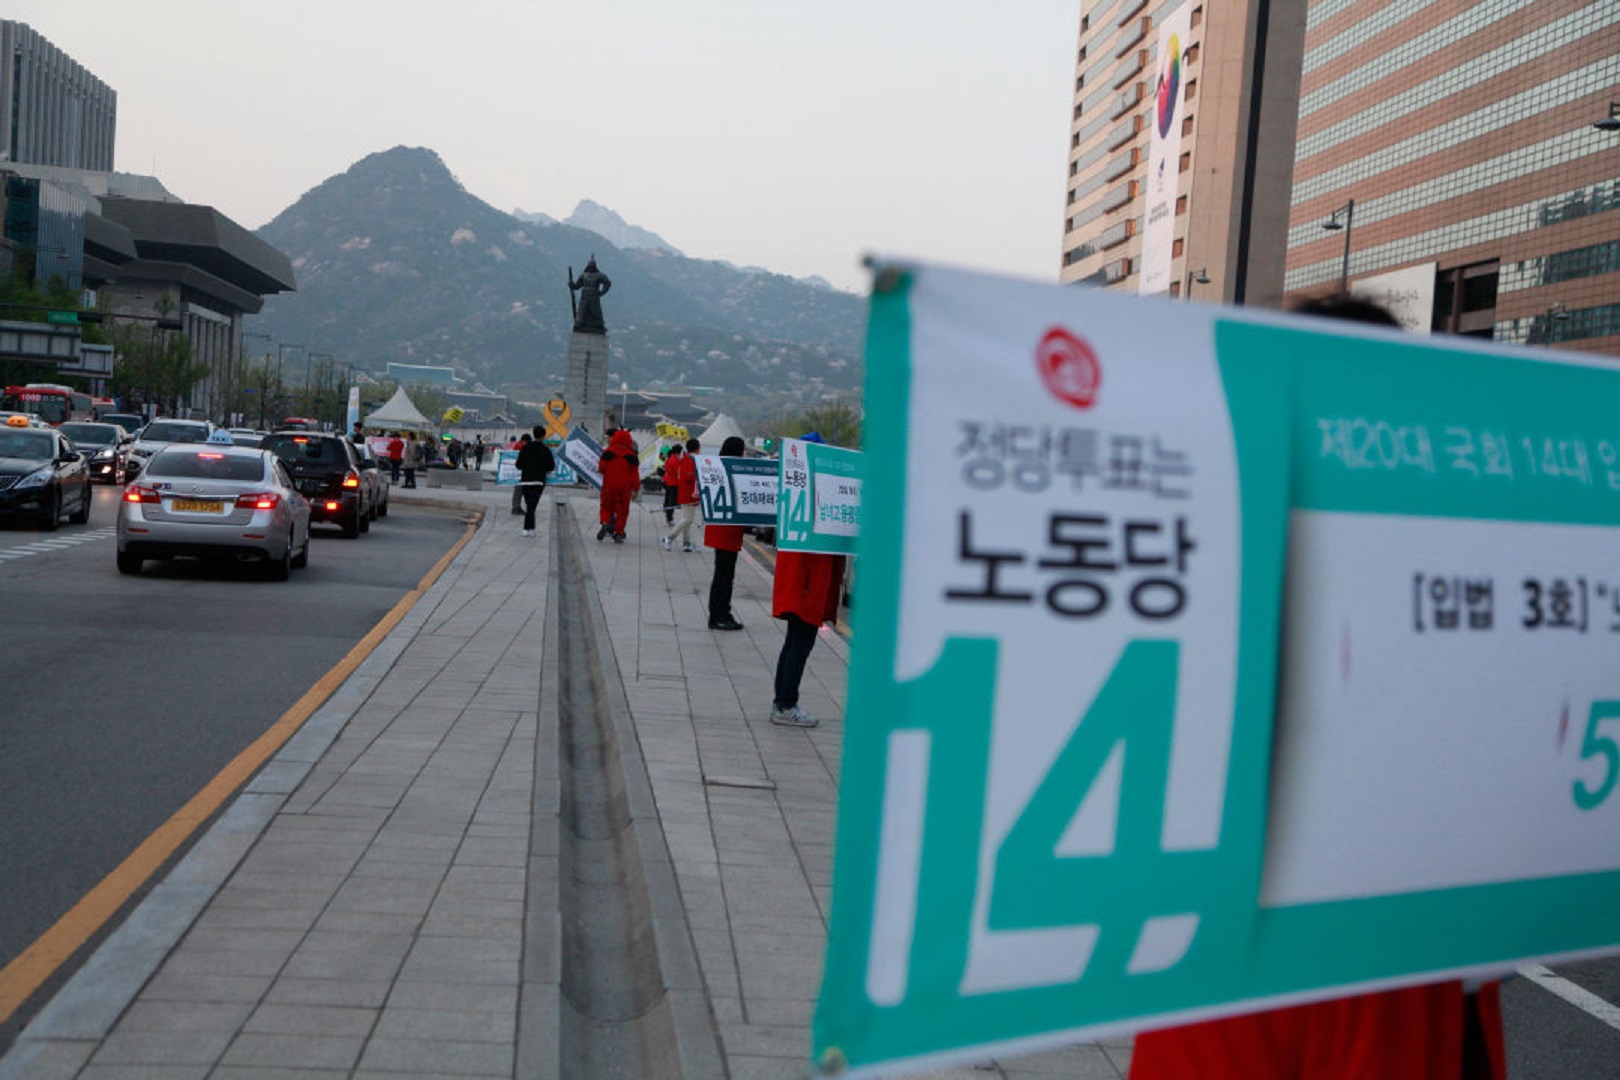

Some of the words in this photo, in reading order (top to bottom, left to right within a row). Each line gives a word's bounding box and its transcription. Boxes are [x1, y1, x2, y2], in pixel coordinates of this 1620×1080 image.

[701, 473, 726, 486] 노동당
[784, 470, 807, 489] 노동당
[956, 419, 1195, 500] 정당투표는
[1316, 416, 1437, 475] 제20대
[1444, 424, 1514, 482] 국회
[1520, 436, 1593, 489] 14대
[943, 508, 1198, 623] 노동당
[1412, 571, 1495, 634] [입법
